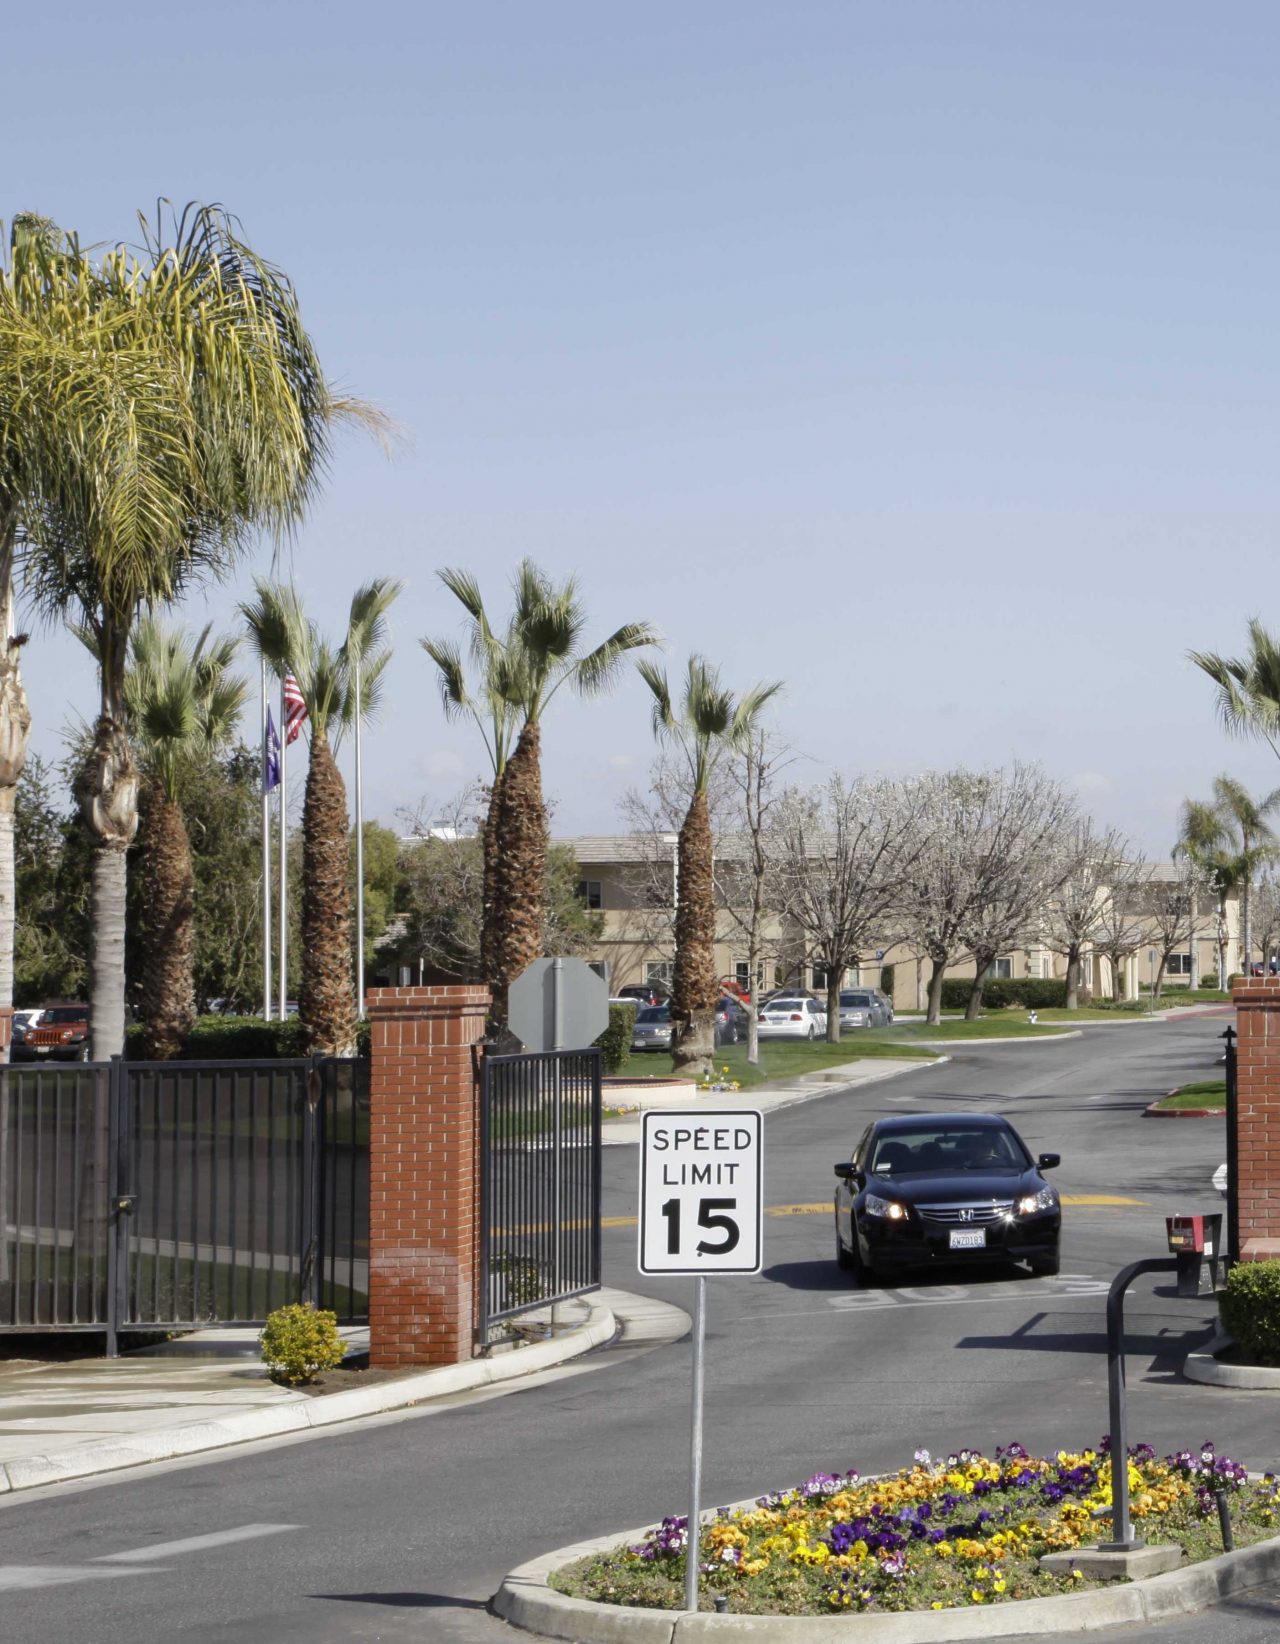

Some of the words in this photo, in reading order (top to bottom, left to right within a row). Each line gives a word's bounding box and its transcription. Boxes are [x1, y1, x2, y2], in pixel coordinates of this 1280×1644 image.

[653, 1127, 751, 1151] SPEED
[663, 1163, 740, 1185] LIMIT
[661, 1198, 740, 1255] 15
